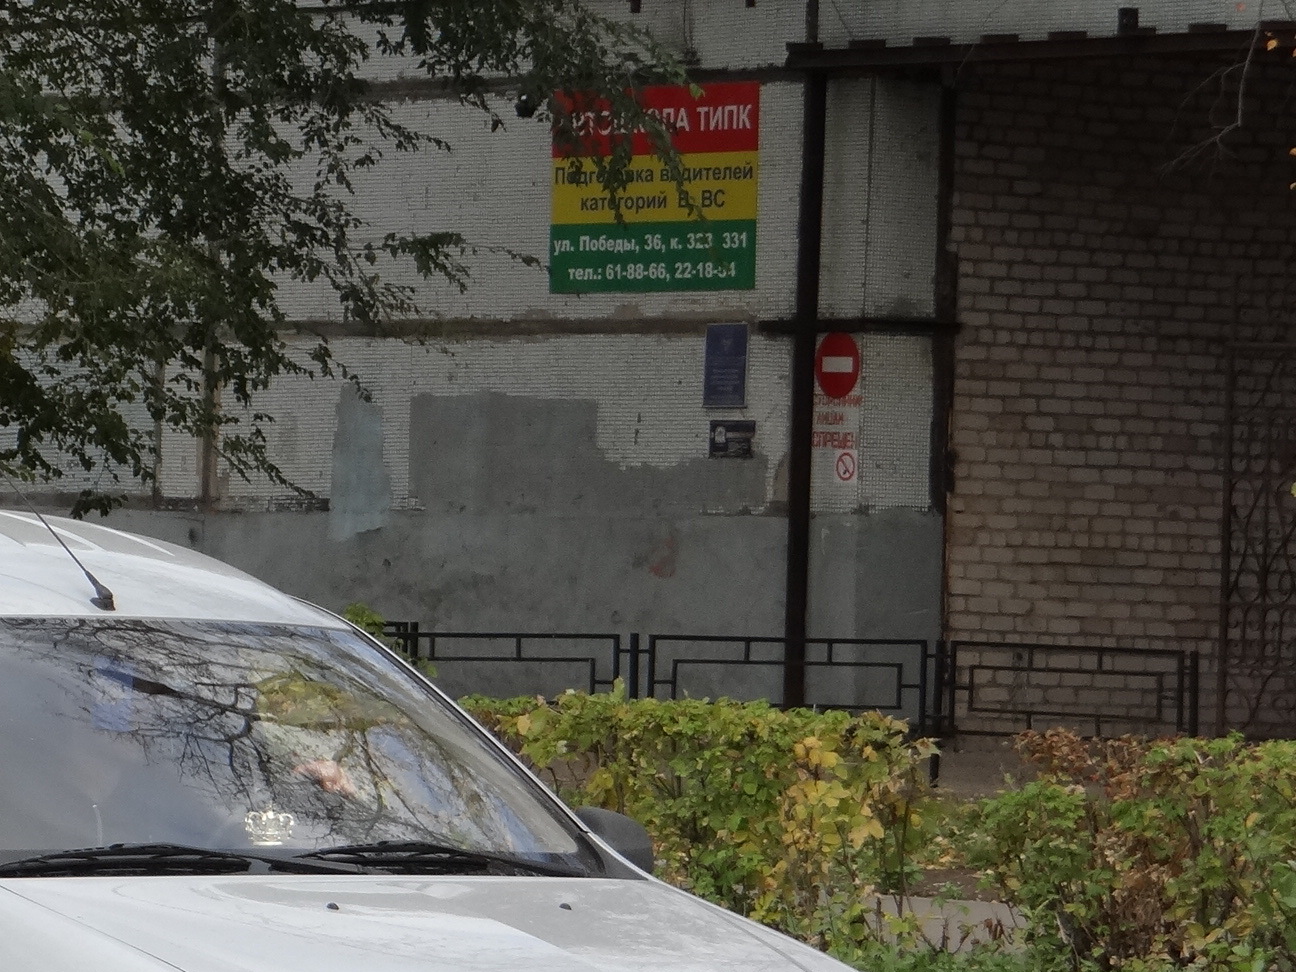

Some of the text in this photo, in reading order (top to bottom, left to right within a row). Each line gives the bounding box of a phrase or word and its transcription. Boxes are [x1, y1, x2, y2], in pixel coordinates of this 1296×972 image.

[696, 104, 752, 131] ТИПК
[554, 161, 754, 186] Пдгвка вдителей
[580, 191, 667, 214] катгорий
[701, 189, 726, 208] ВС
[554, 239, 574, 255] ул.
[579, 235, 639, 253] Победы,
[644, 234, 665, 252] 36,
[670, 237, 682, 250] к.
[722, 232, 748, 248] 331
[568, 266, 602, 281] тел.:
[606, 263, 670, 282] 61-88-66,
